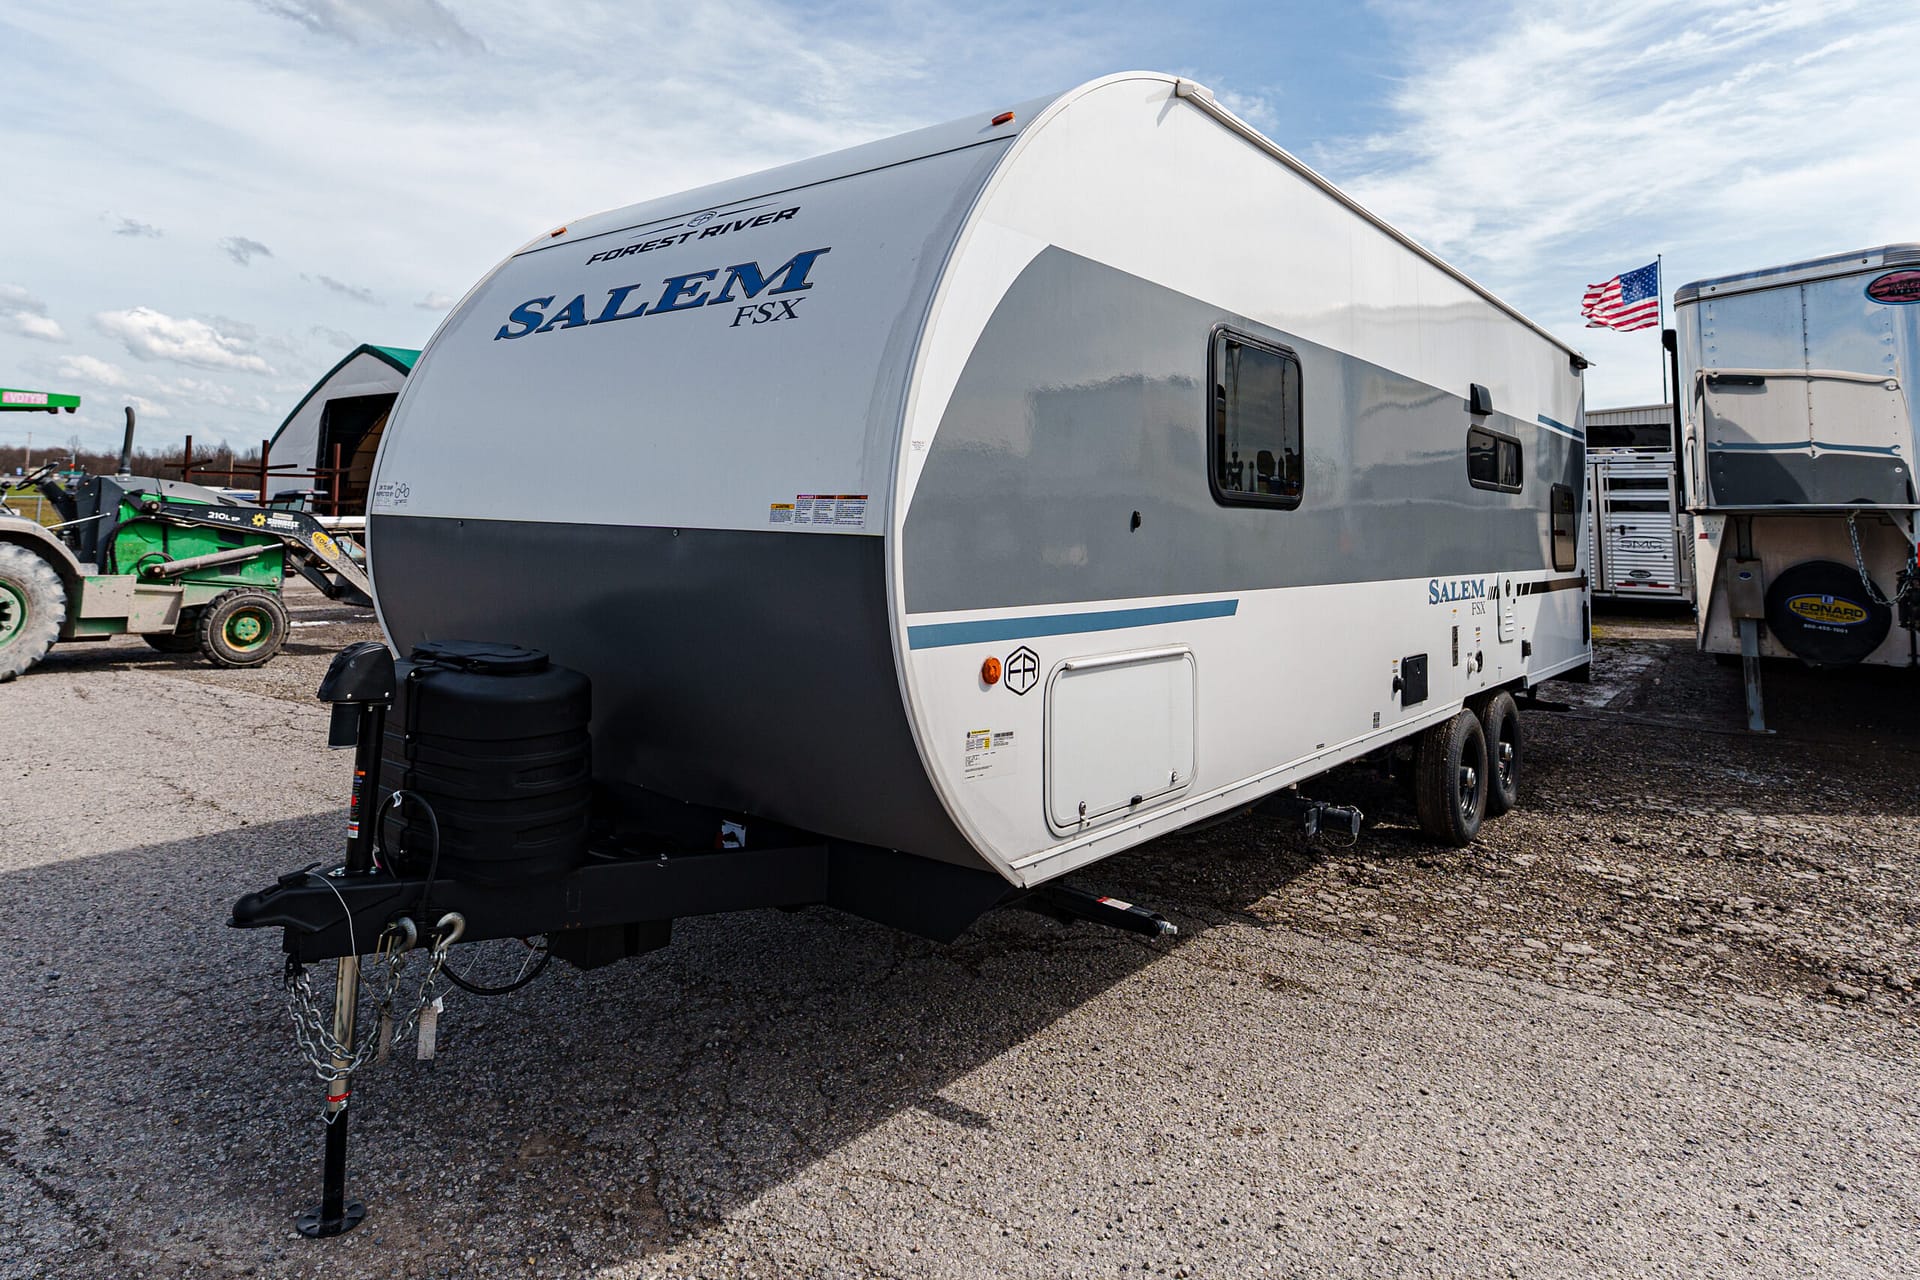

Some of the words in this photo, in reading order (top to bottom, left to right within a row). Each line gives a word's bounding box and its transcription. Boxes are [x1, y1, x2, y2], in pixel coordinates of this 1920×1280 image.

[586, 230, 699, 266] FOREST
[698, 206, 801, 241] RIVER
[494, 247, 832, 341] SALEM
[729, 297, 807, 328] FSX
[1428, 578, 1486, 605] SALEM
[1471, 600, 1486, 616] FSX
[1791, 601, 1864, 618] LEONARD
